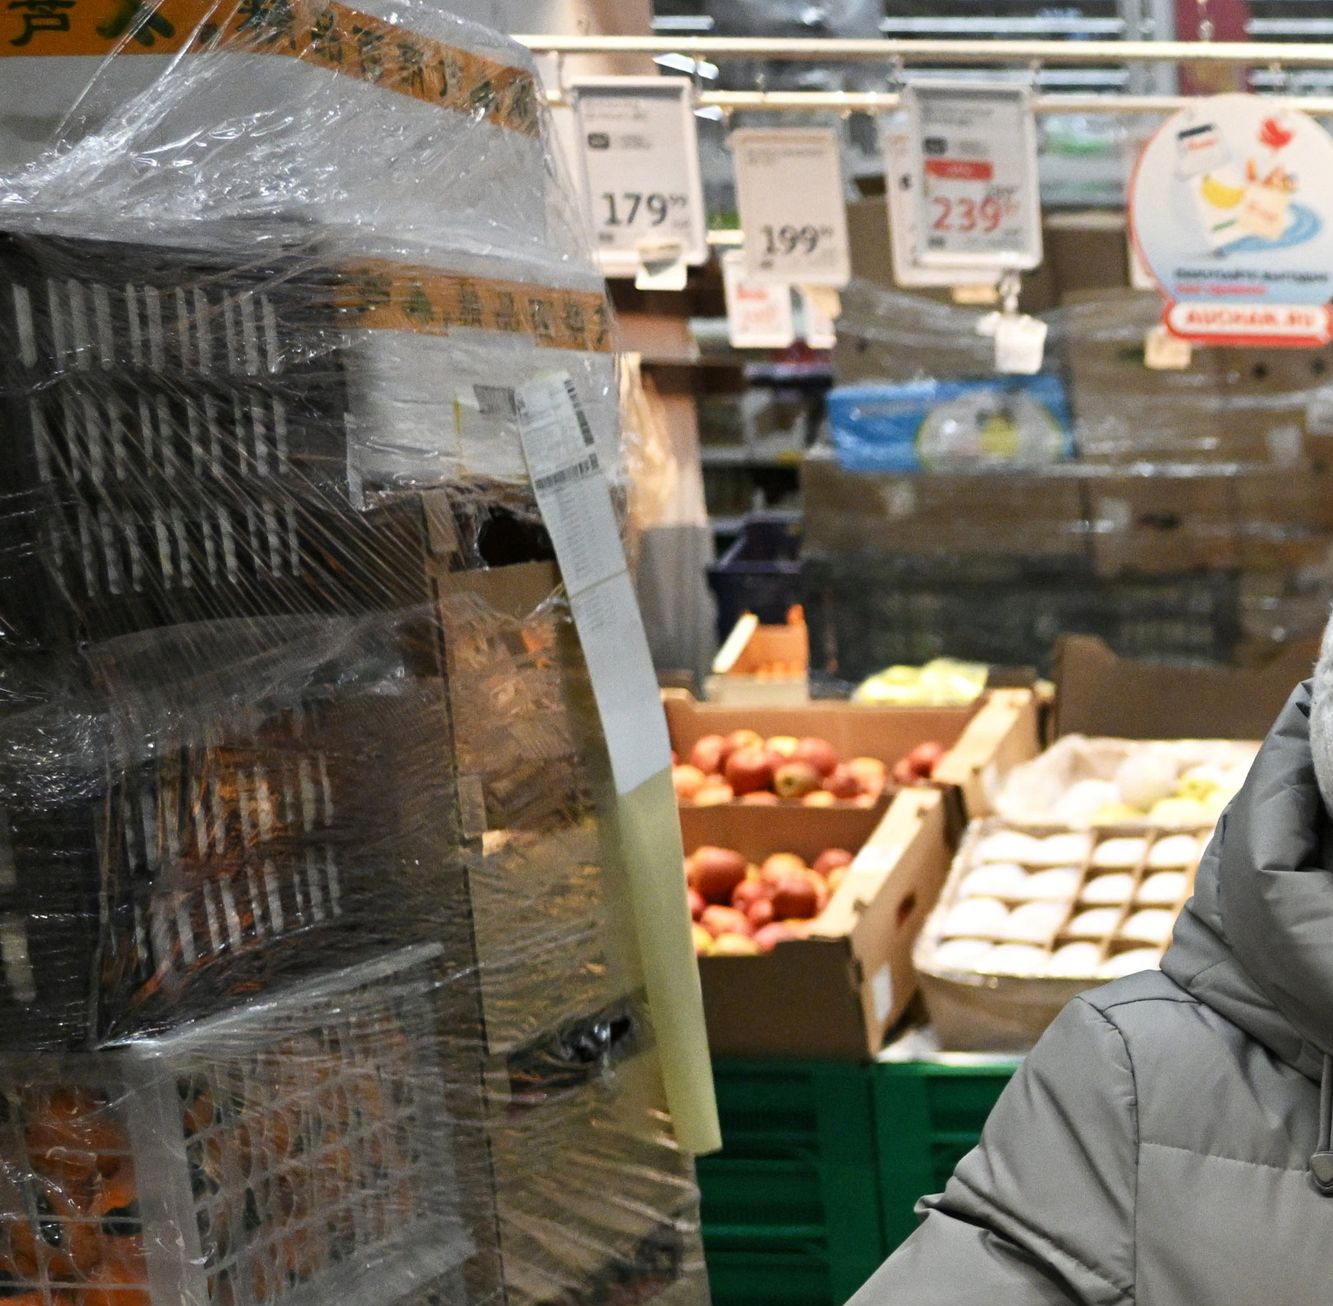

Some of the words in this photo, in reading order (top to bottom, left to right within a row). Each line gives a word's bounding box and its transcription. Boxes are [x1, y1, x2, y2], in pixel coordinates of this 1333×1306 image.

[602, 193, 668, 226] 179
[932, 196, 1001, 233] 239
[761, 224, 819, 255] 199
